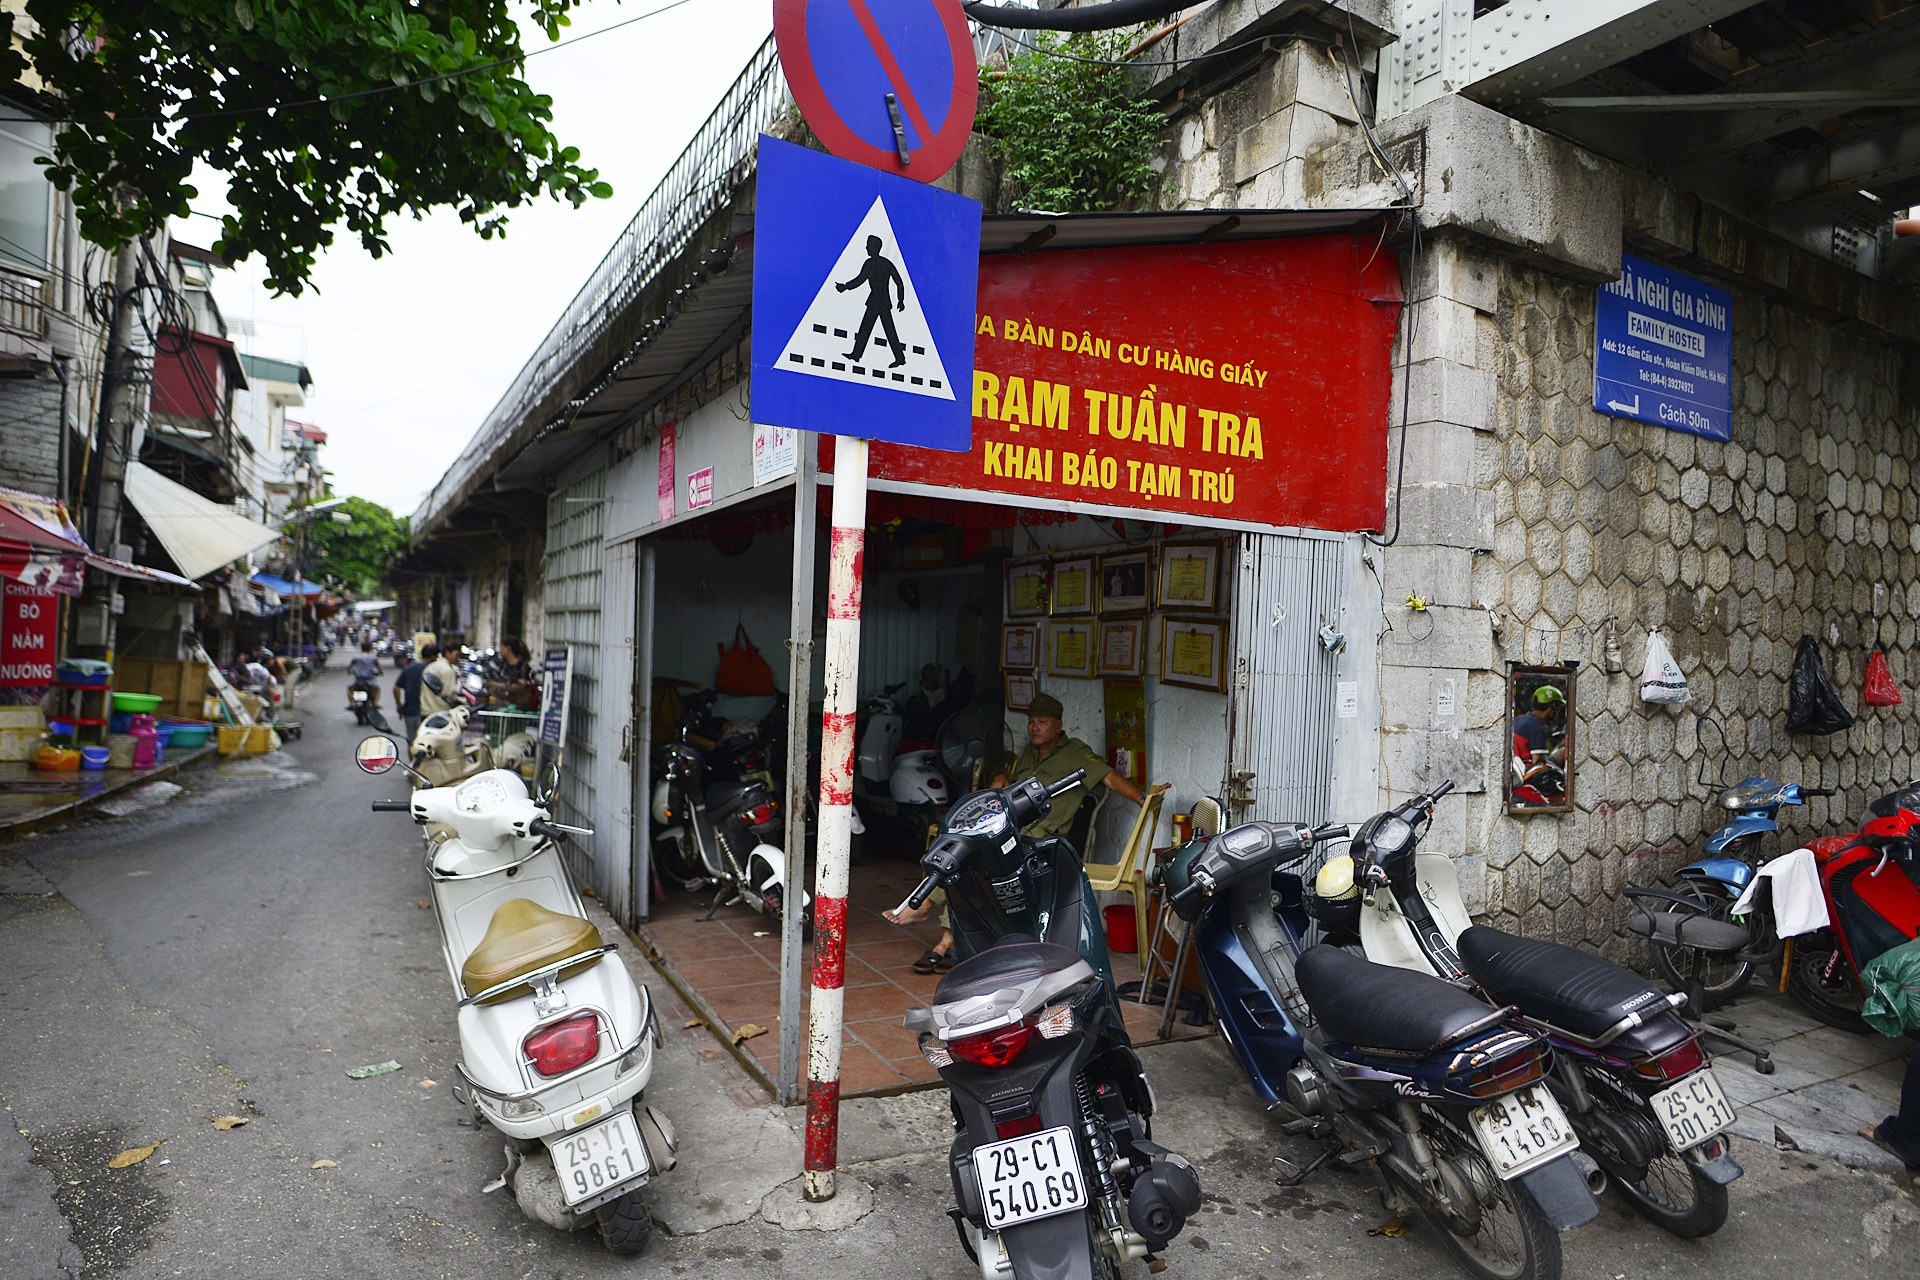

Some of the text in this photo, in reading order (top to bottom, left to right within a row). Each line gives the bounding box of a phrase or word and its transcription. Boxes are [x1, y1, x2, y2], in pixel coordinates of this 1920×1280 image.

[1637, 276, 1669, 312] NGHỈ
[1672, 289, 1693, 321] GIA
[1696, 294, 1726, 332] ĐÌNH
[1004, 317, 1055, 348] BÀN
[1061, 331, 1111, 359] DÂN
[1117, 342, 1151, 366] CƯ
[1155, 348, 1214, 379] HÀNG
[1220, 359, 1269, 389] GIẤY
[1602, 338, 1617, 352] Add:
[1617, 344, 1626, 355] 12
[1665, 357, 1680, 371] Hoàn
[1631, 317, 1703, 352] FAMILY HOSTEL
[1639, 369, 1650, 382] Tel:
[1084, 383, 1187, 448] TUẦN
[1198, 408, 1264, 460] TRA
[1659, 402, 1710, 430] Cách 50m
[983, 440, 1235, 504] KHAI BÁO TẠM TRÚ
[19, 601, 40, 619] BÒ
[1621, 991, 1655, 1011] HONDA
[991, 1085, 1024, 1098] HONDA
[1394, 1081, 1444, 1098] Viva
[1662, 1077, 1714, 1119] 29-C1
[565, 1121, 626, 1168] 29-Y1
[1500, 1116, 1561, 1161] 1460
[1670, 1098, 1731, 1146] 301.31
[573, 1147, 635, 1195] 9861
[989, 1135, 1061, 1182] 29-C1
[988, 1171, 1079, 1221] 540.69
